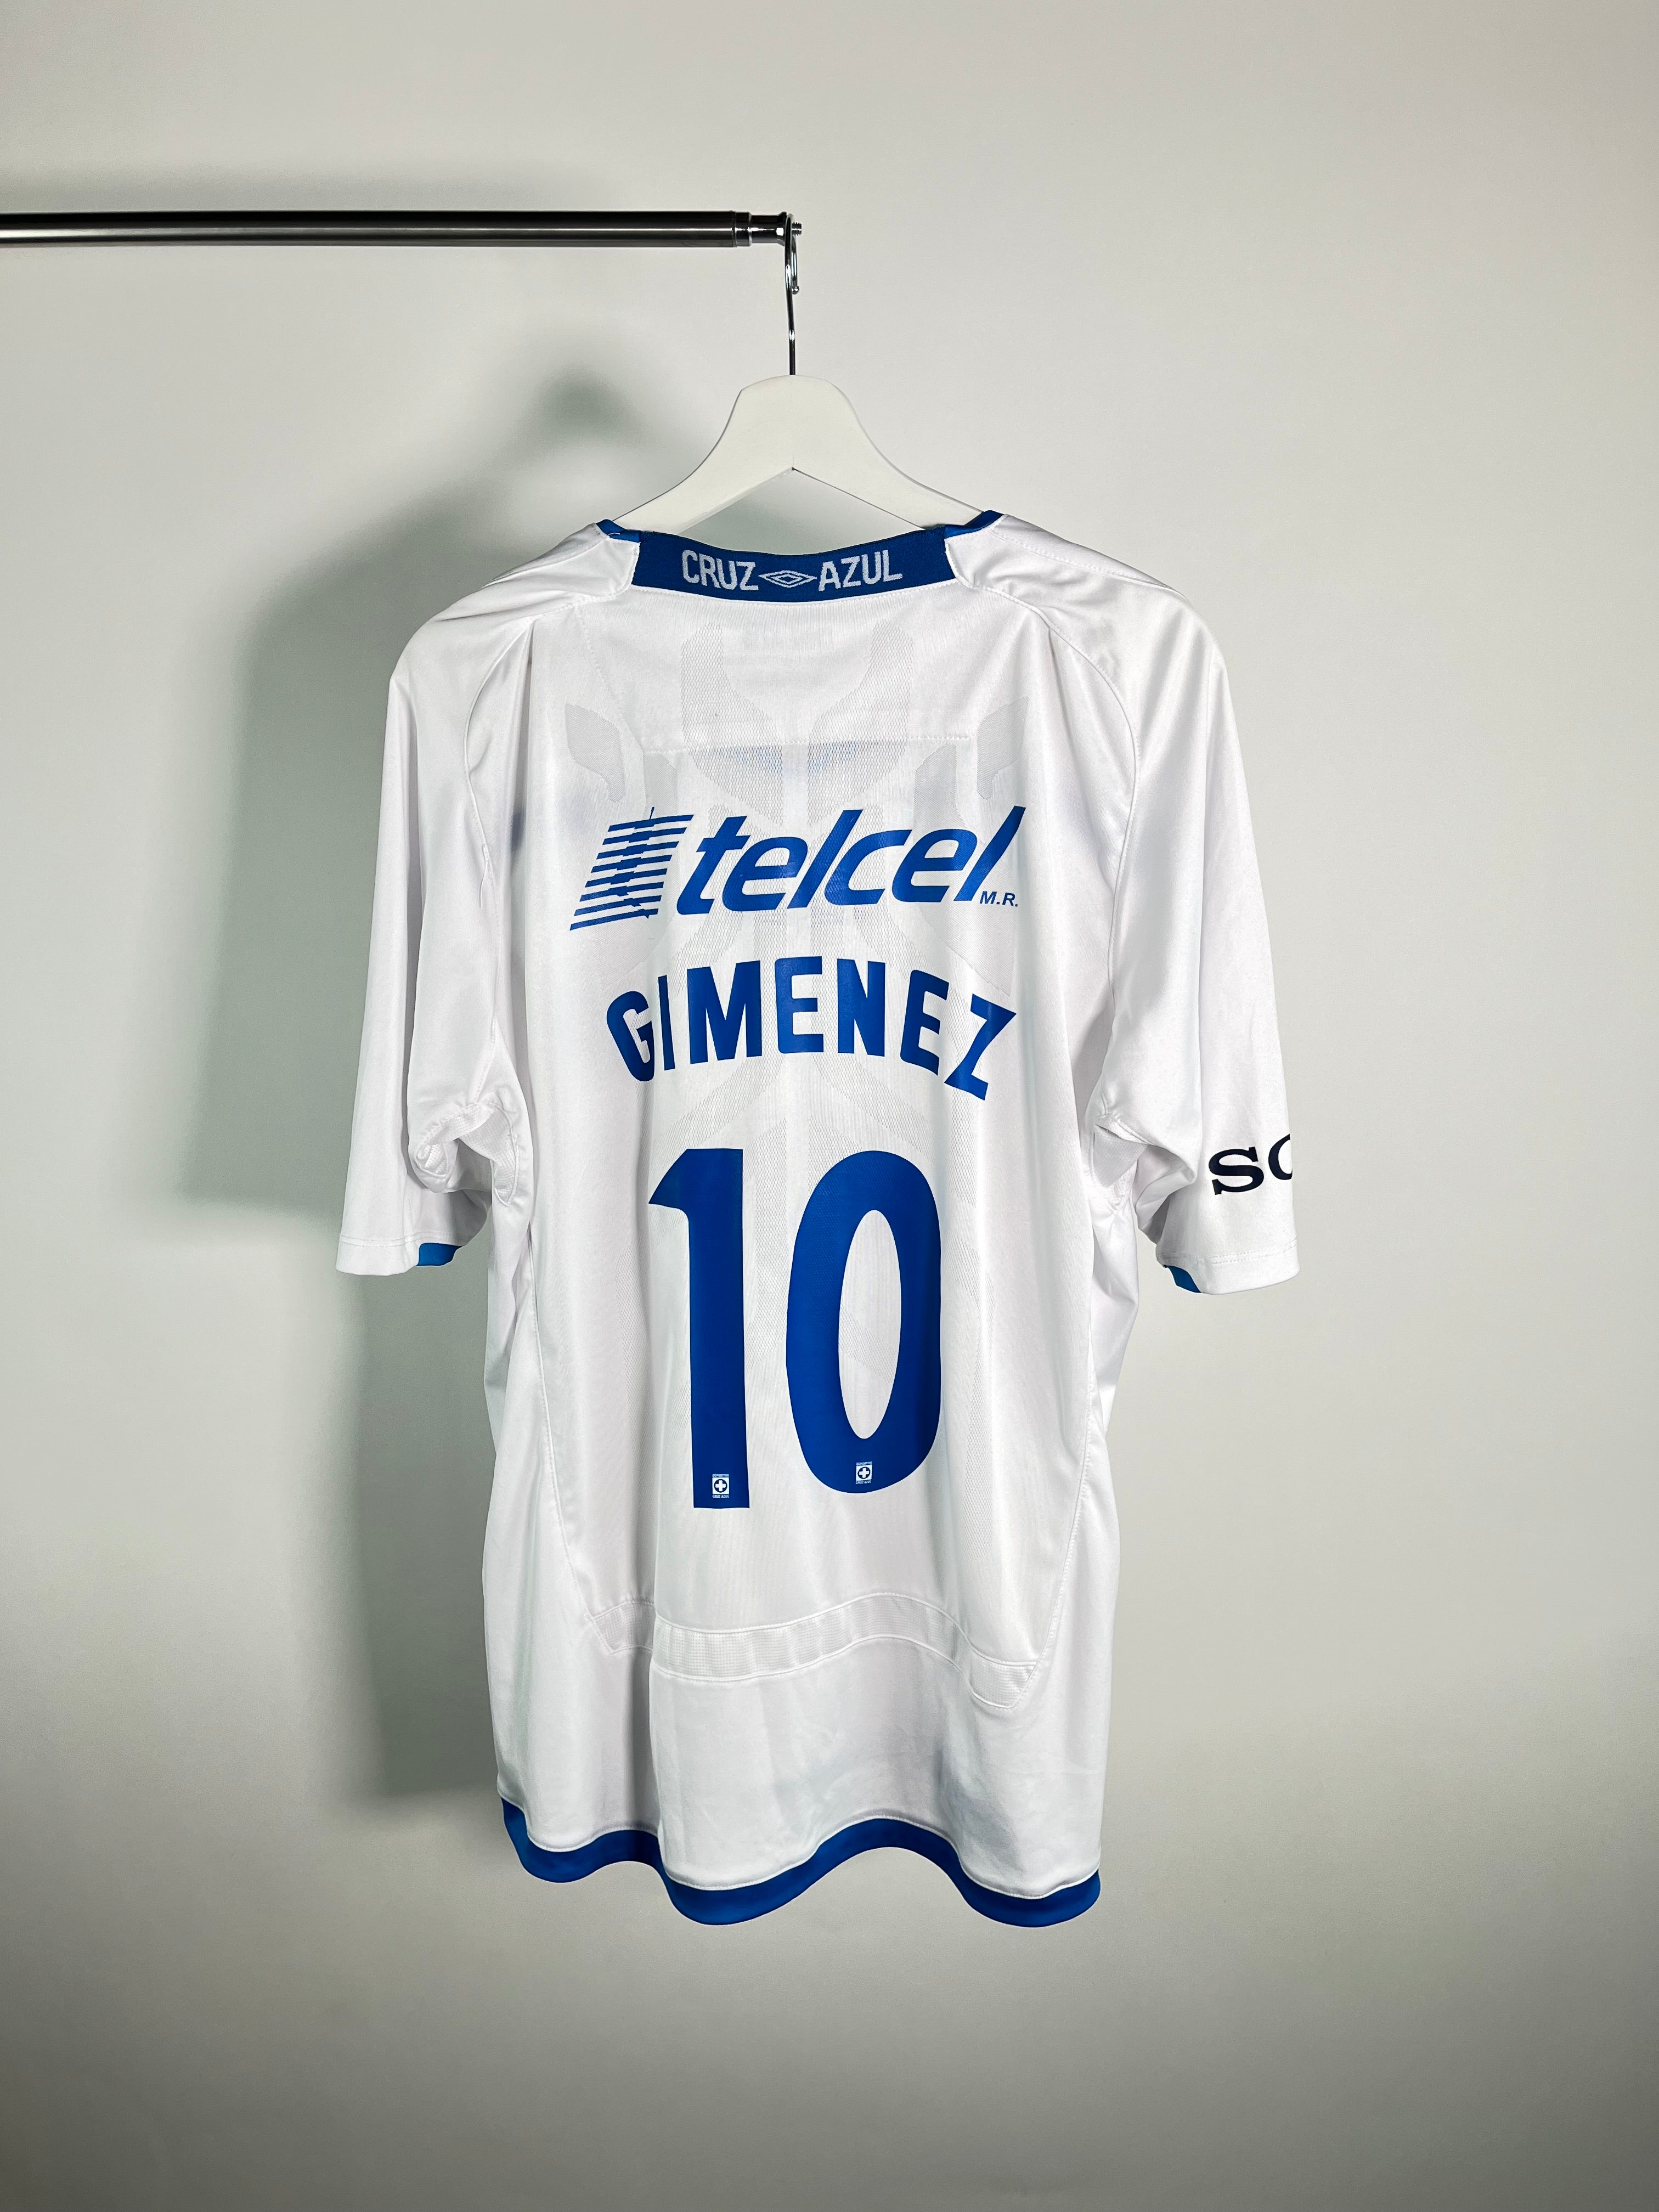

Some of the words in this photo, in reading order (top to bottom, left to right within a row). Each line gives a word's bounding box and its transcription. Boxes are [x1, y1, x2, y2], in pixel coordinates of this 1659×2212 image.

[681, 550, 759, 591] CRUZ
[818, 549, 903, 591] AZUL
[676, 805, 1025, 912] telcel
[980, 891, 1019, 907] M.R.
[606, 956, 1017, 1101] GIMENEZ
[648, 1148, 941, 1509] 10
